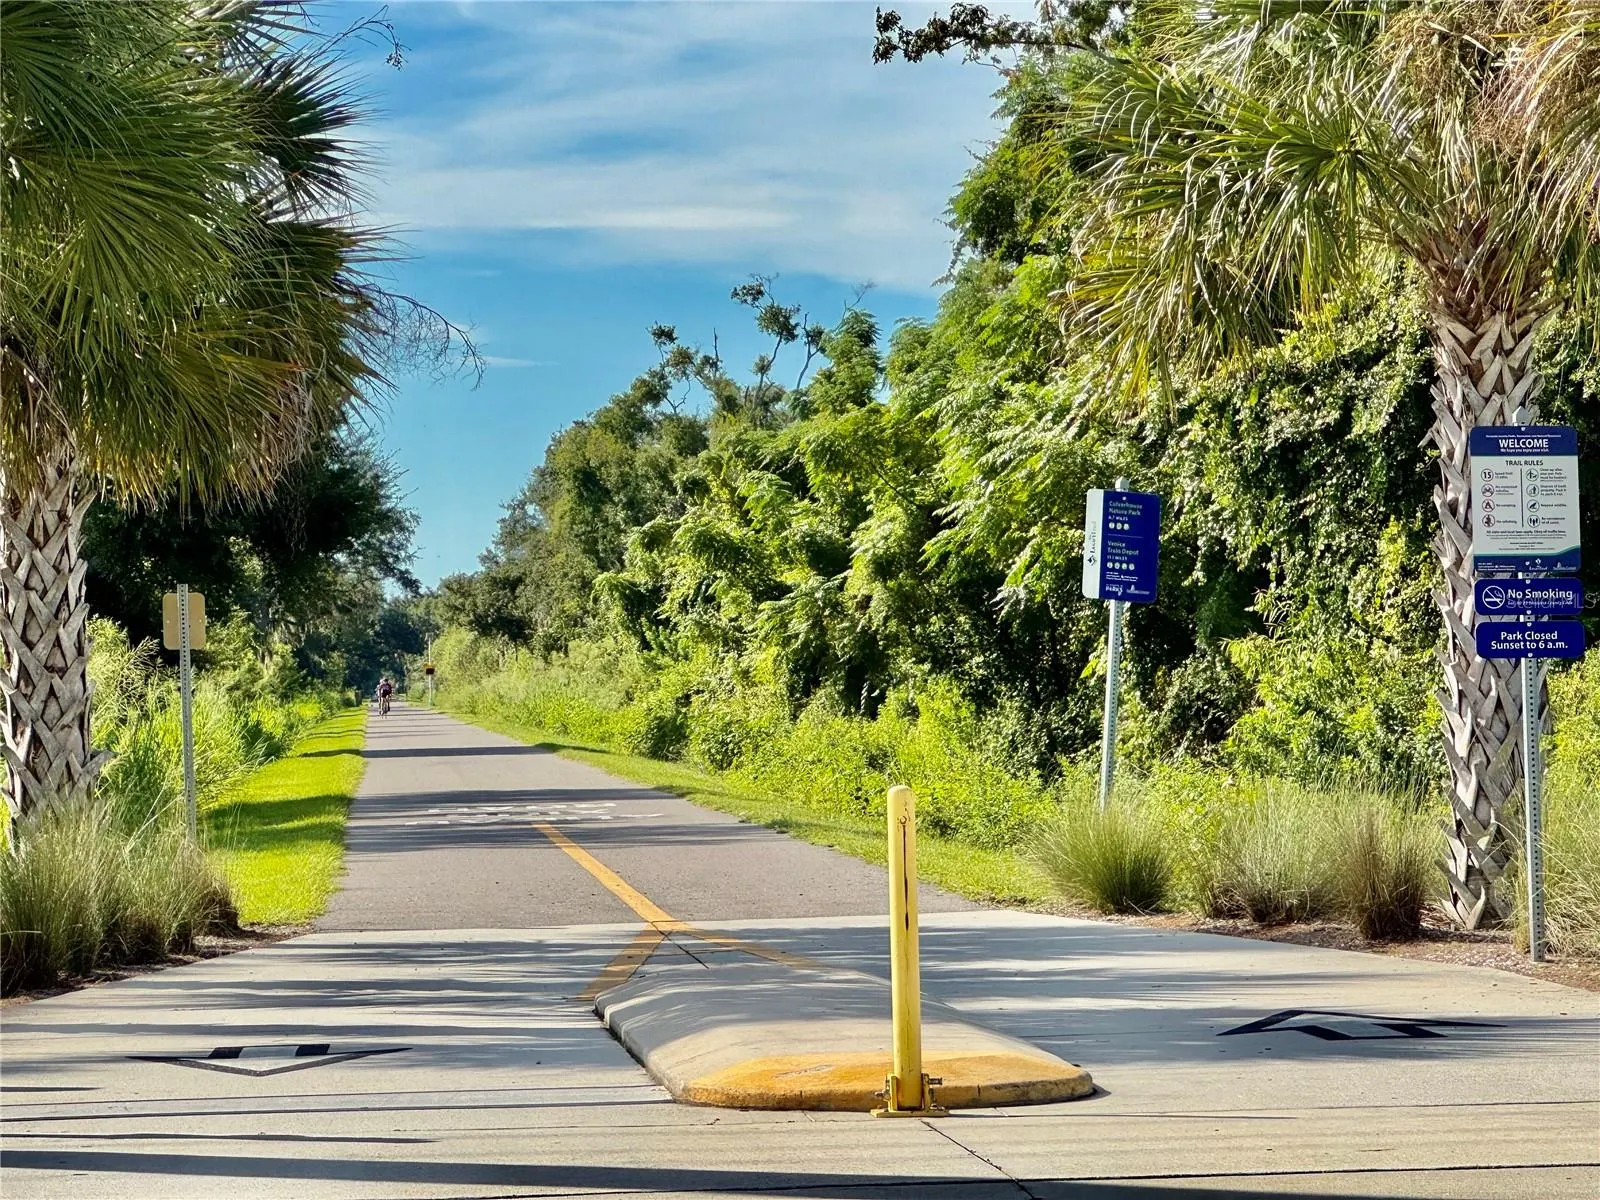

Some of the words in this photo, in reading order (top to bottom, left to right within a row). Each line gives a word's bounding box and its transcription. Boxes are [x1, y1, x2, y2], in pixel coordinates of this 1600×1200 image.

[1499, 439, 1549, 448] WELCOME
[1508, 590, 1522, 598] No
[1526, 589, 1572, 600] Smoking
[1501, 632, 1522, 640] Park
[1525, 631, 1558, 640] Closed
[1491, 641, 1524, 650] Sunset
[1526, 641, 1536, 649] to
[1538, 641, 1545, 649] 6
